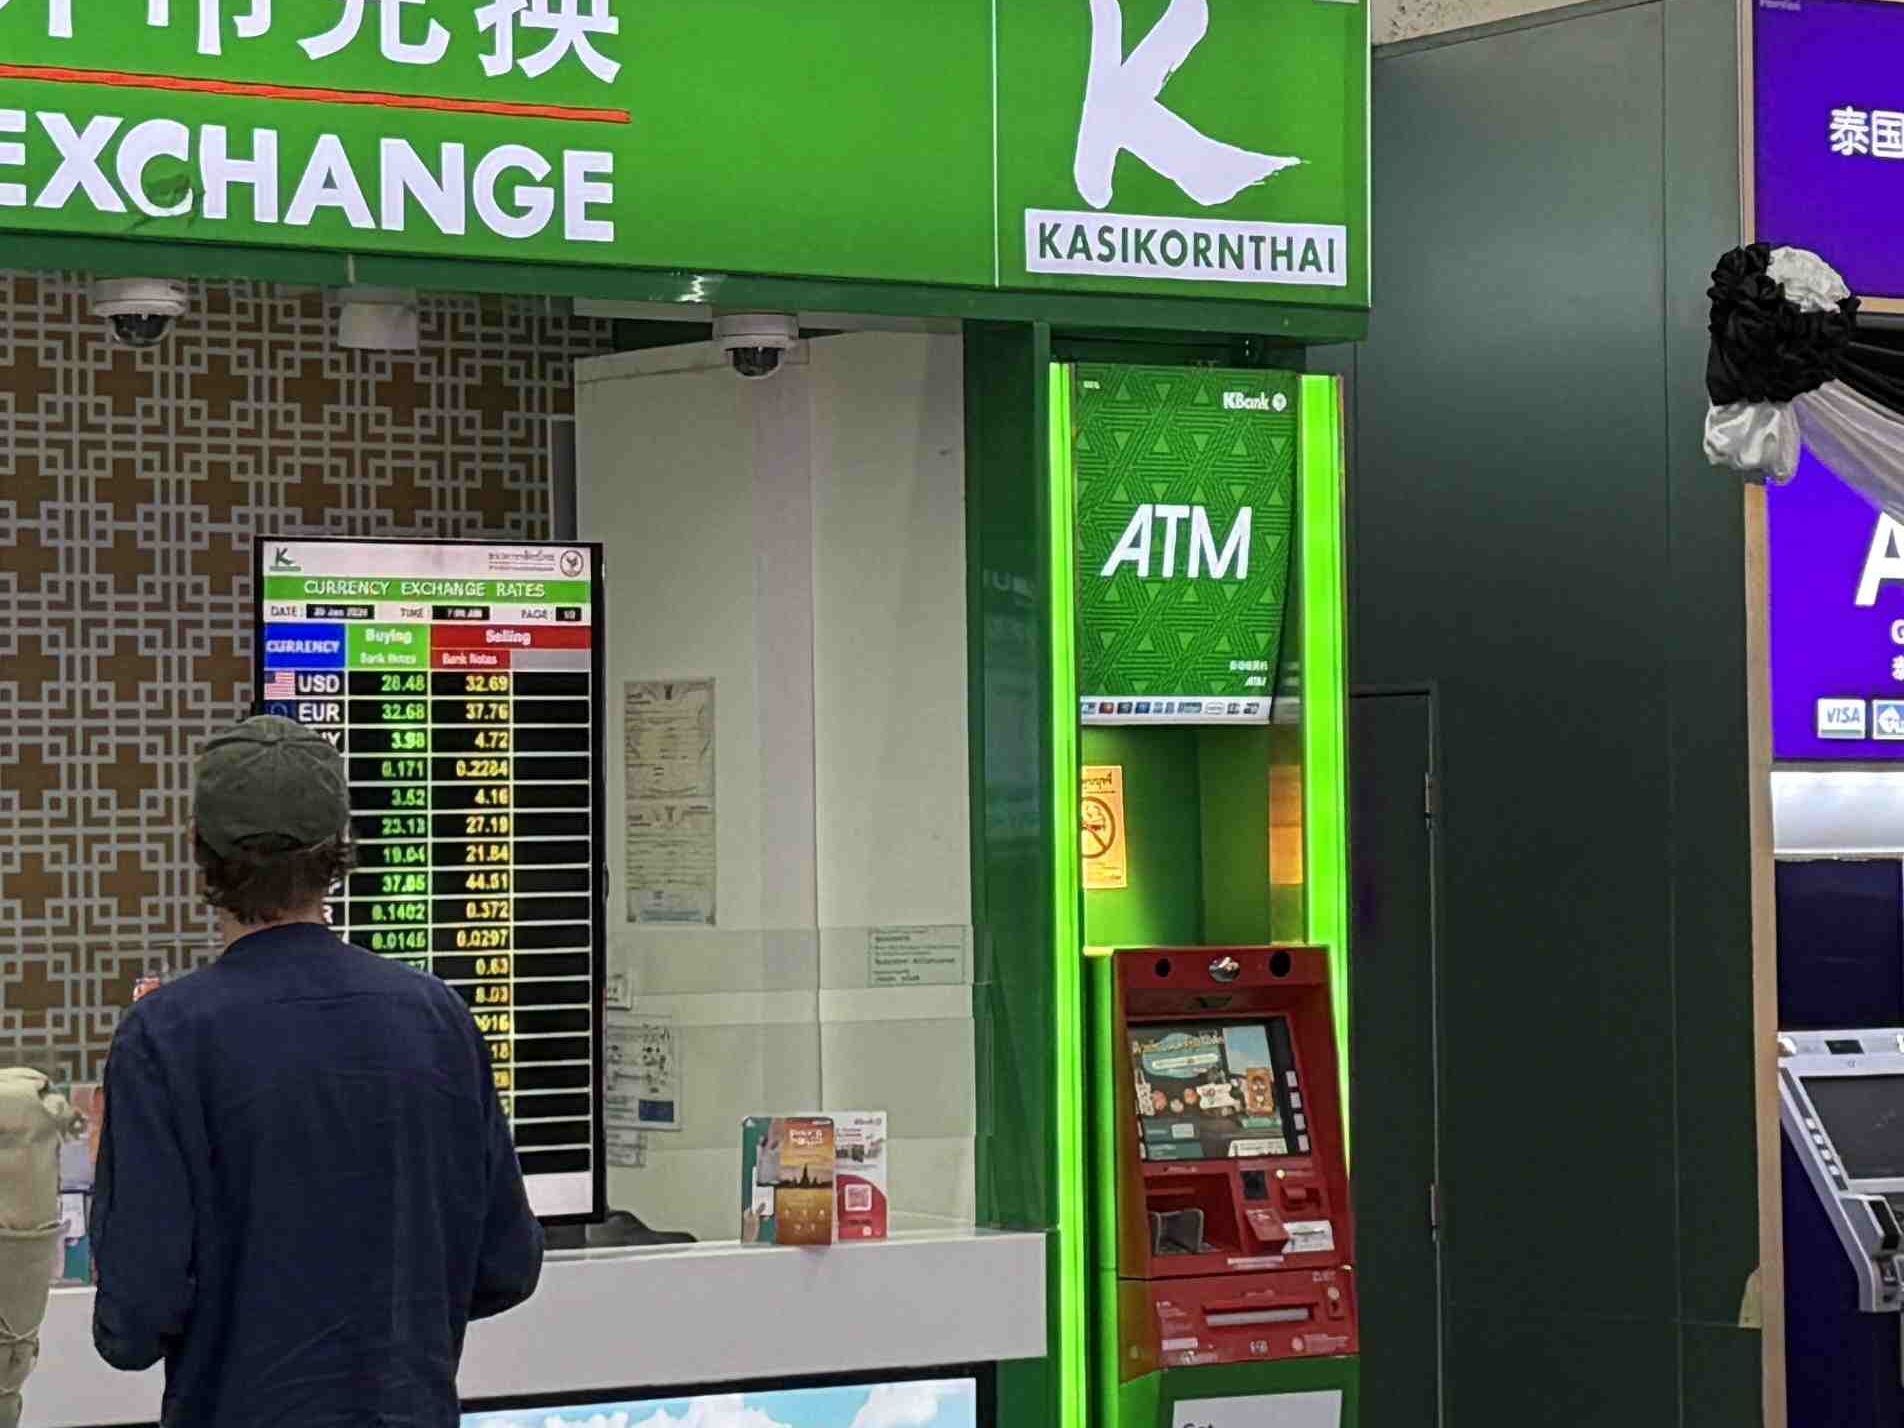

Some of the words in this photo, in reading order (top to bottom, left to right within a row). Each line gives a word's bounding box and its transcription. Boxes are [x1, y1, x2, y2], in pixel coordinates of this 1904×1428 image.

[1037, 222, 1339, 276] KASIKORNTHAI
[1100, 504, 1252, 579] ATM
[304, 580, 390, 596] CURRENCY
[400, 581, 486, 597] EXCHANGE
[496, 583, 546, 598] RATES
[365, 629, 413, 645] Buying
[485, 630, 532, 646] Selling
[298, 674, 340, 693] USD
[298, 702, 341, 722] EUR
[1826, 706, 1861, 724] VISA
[474, 731, 509, 749] 4.72
